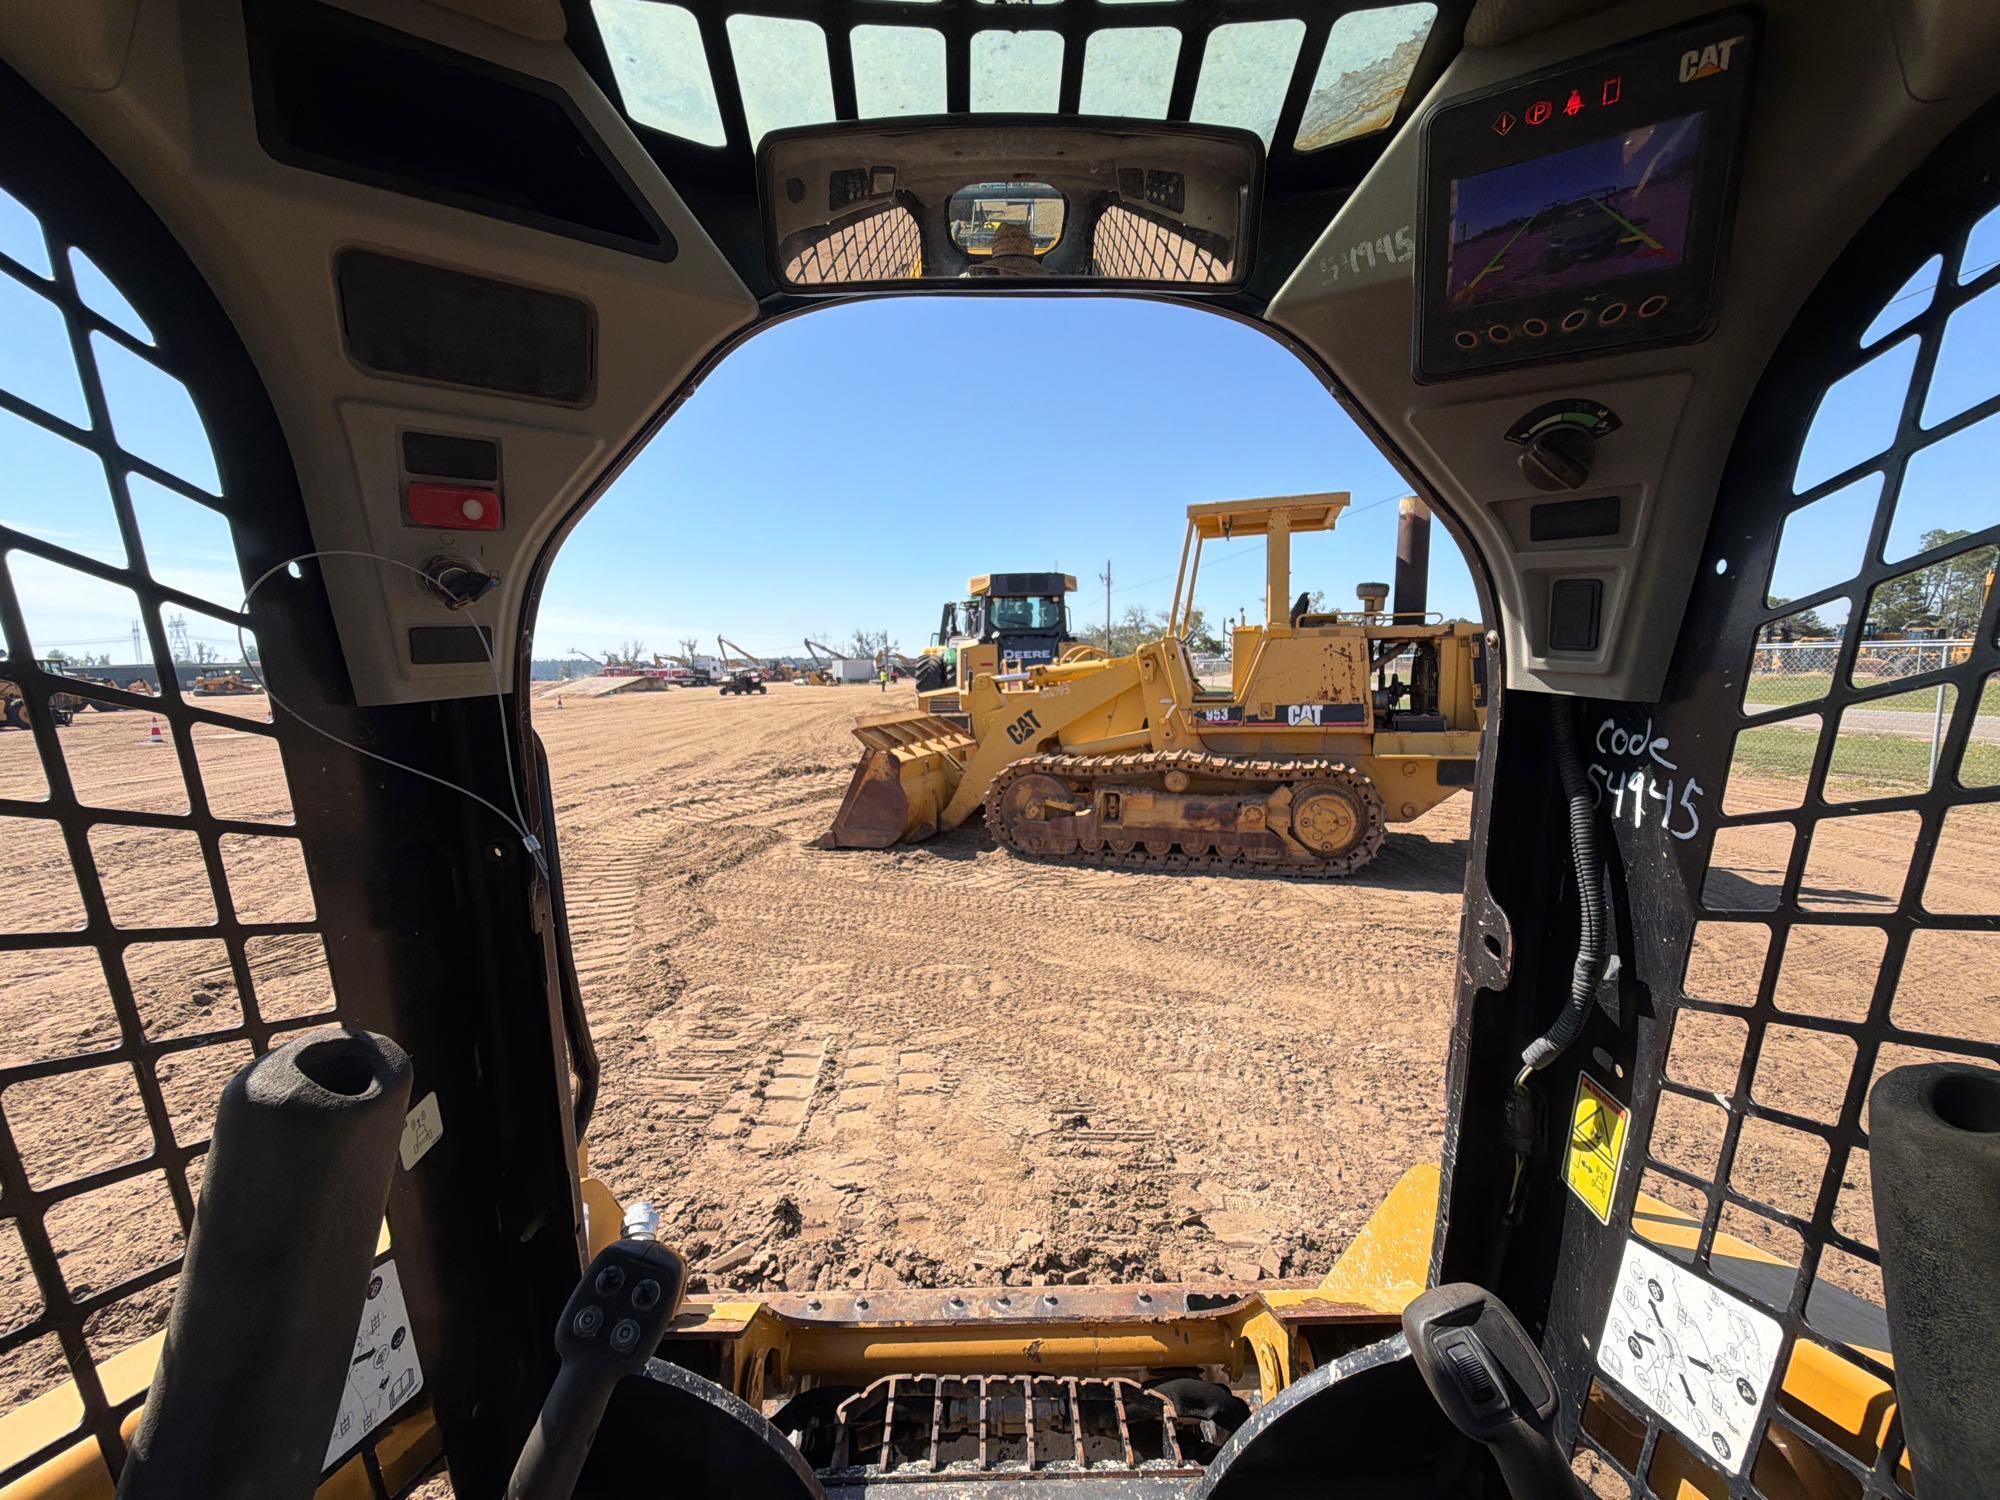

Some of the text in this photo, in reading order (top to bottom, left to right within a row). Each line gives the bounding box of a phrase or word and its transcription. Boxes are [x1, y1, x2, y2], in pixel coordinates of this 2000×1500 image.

[1679, 36, 1744, 83] CAT
[1003, 649, 1051, 660] DEERE
[1006, 708, 1042, 745] CAT
[1205, 708, 1228, 721] 953
[1287, 705, 1323, 726] CAT
[1587, 763, 1704, 840] 54945
